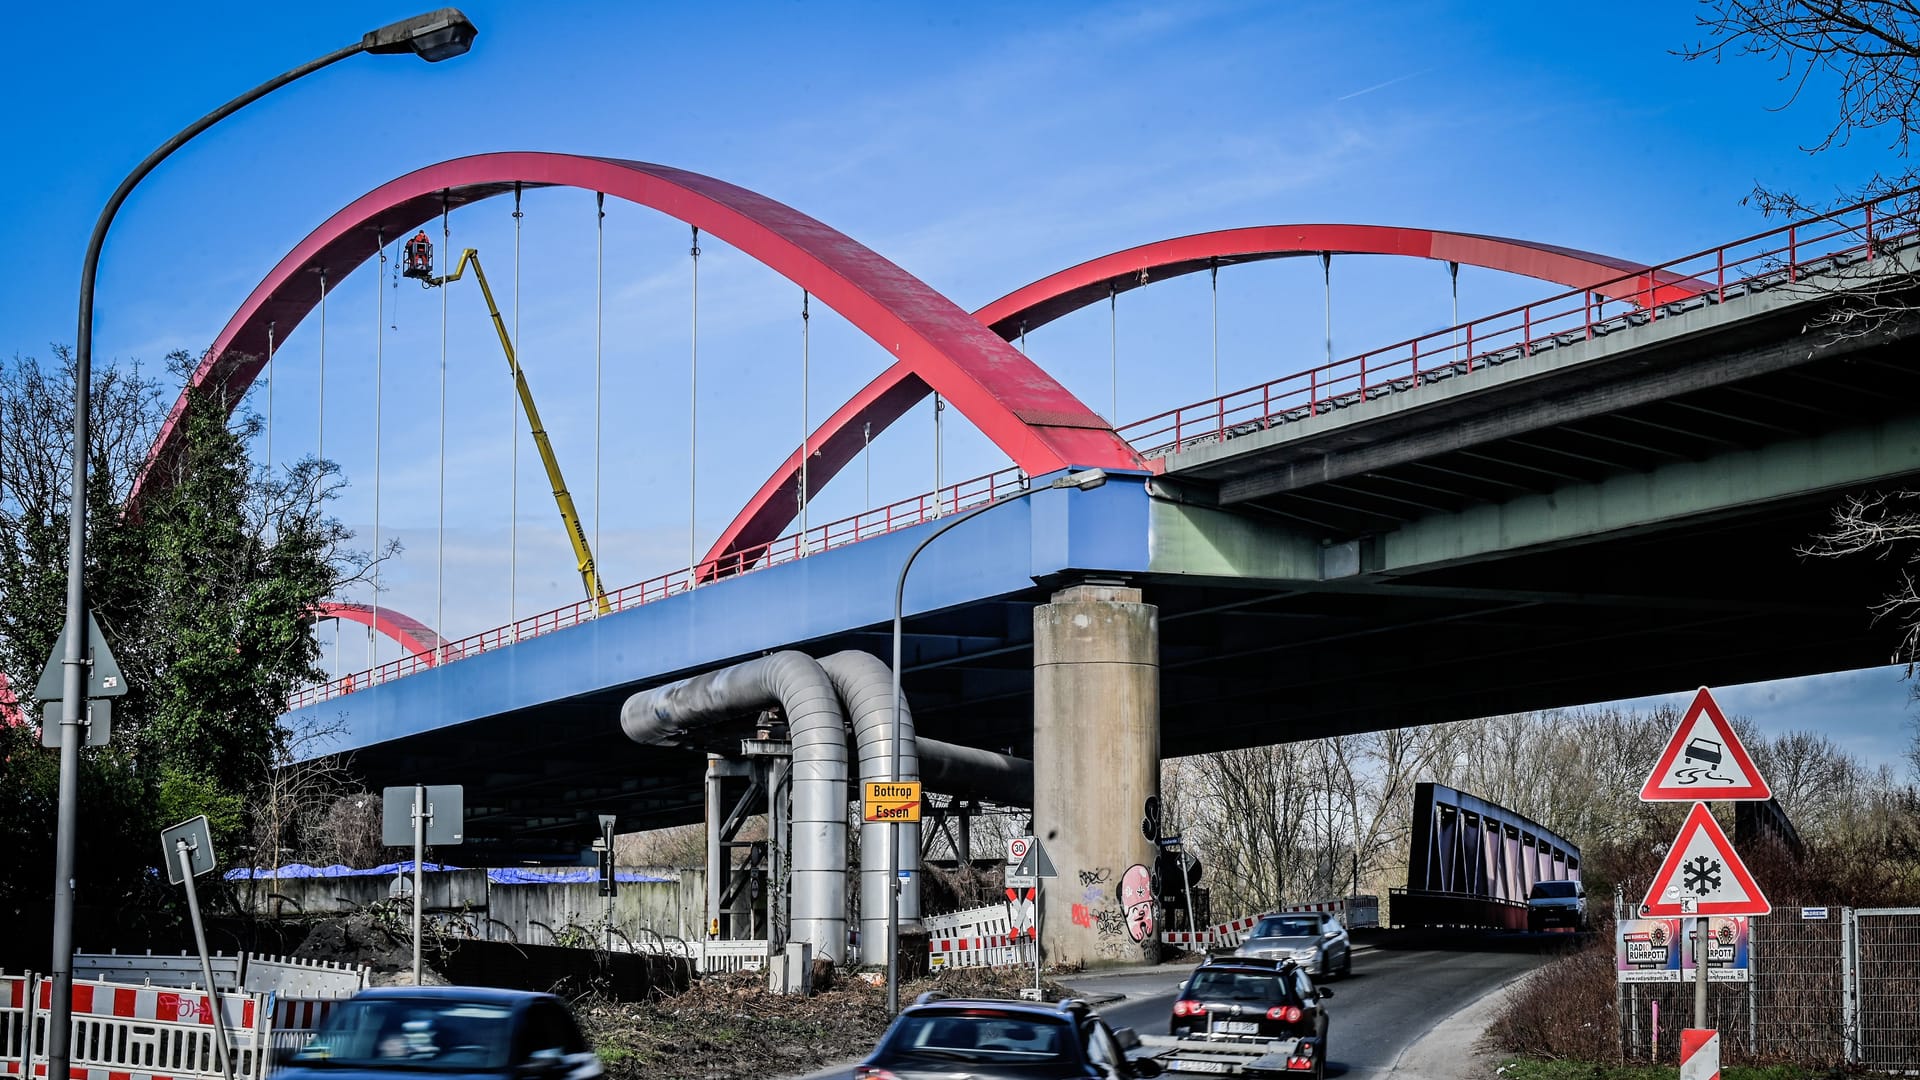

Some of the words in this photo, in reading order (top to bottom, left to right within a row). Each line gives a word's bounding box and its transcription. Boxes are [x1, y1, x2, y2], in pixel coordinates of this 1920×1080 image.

[874, 785, 912, 799] Bottrop
[876, 805, 909, 818] Essen
[1014, 844, 1024, 852] 30
[1629, 943, 1650, 952] RADIO
[1629, 951, 1665, 959] RUHRPOTT
